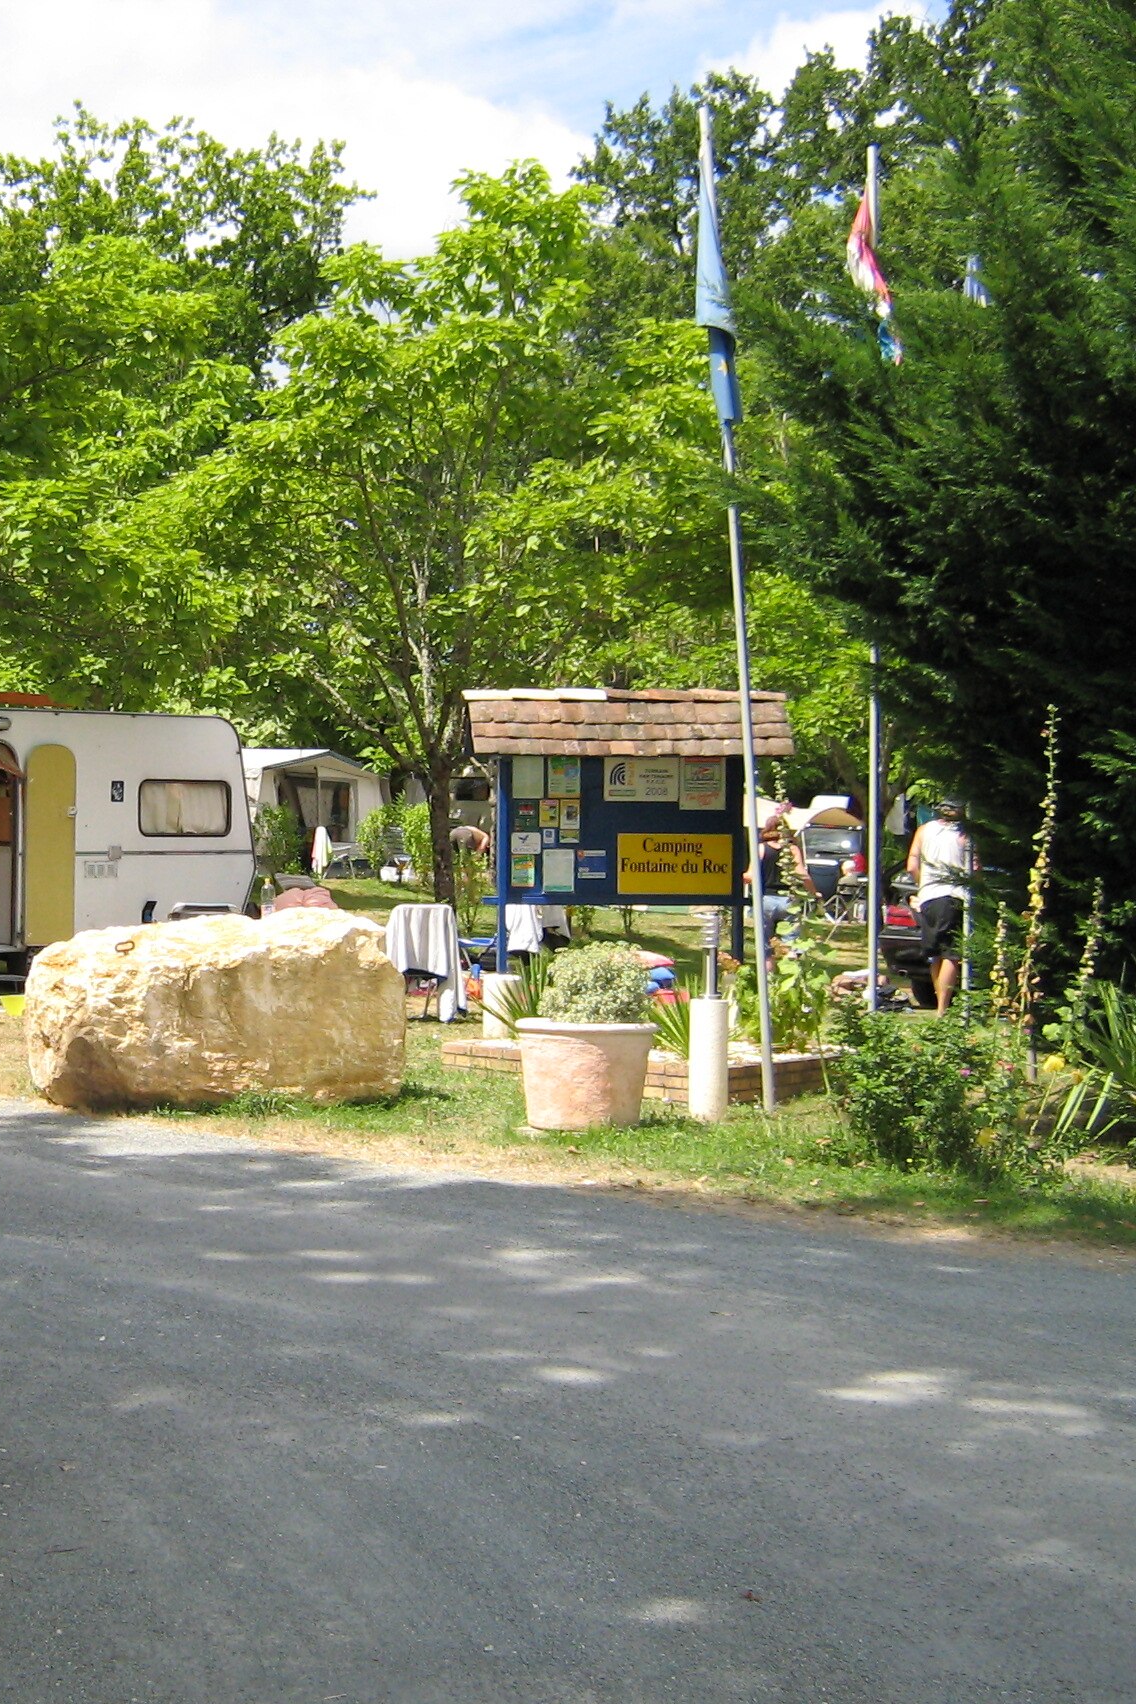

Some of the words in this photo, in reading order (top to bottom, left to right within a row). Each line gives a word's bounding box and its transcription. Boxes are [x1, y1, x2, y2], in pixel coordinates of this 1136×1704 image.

[643, 838, 703, 857] Camping
[621, 858, 677, 873] Fontaine
[681, 859, 700, 874] du
[702, 859, 728, 874] Roc
